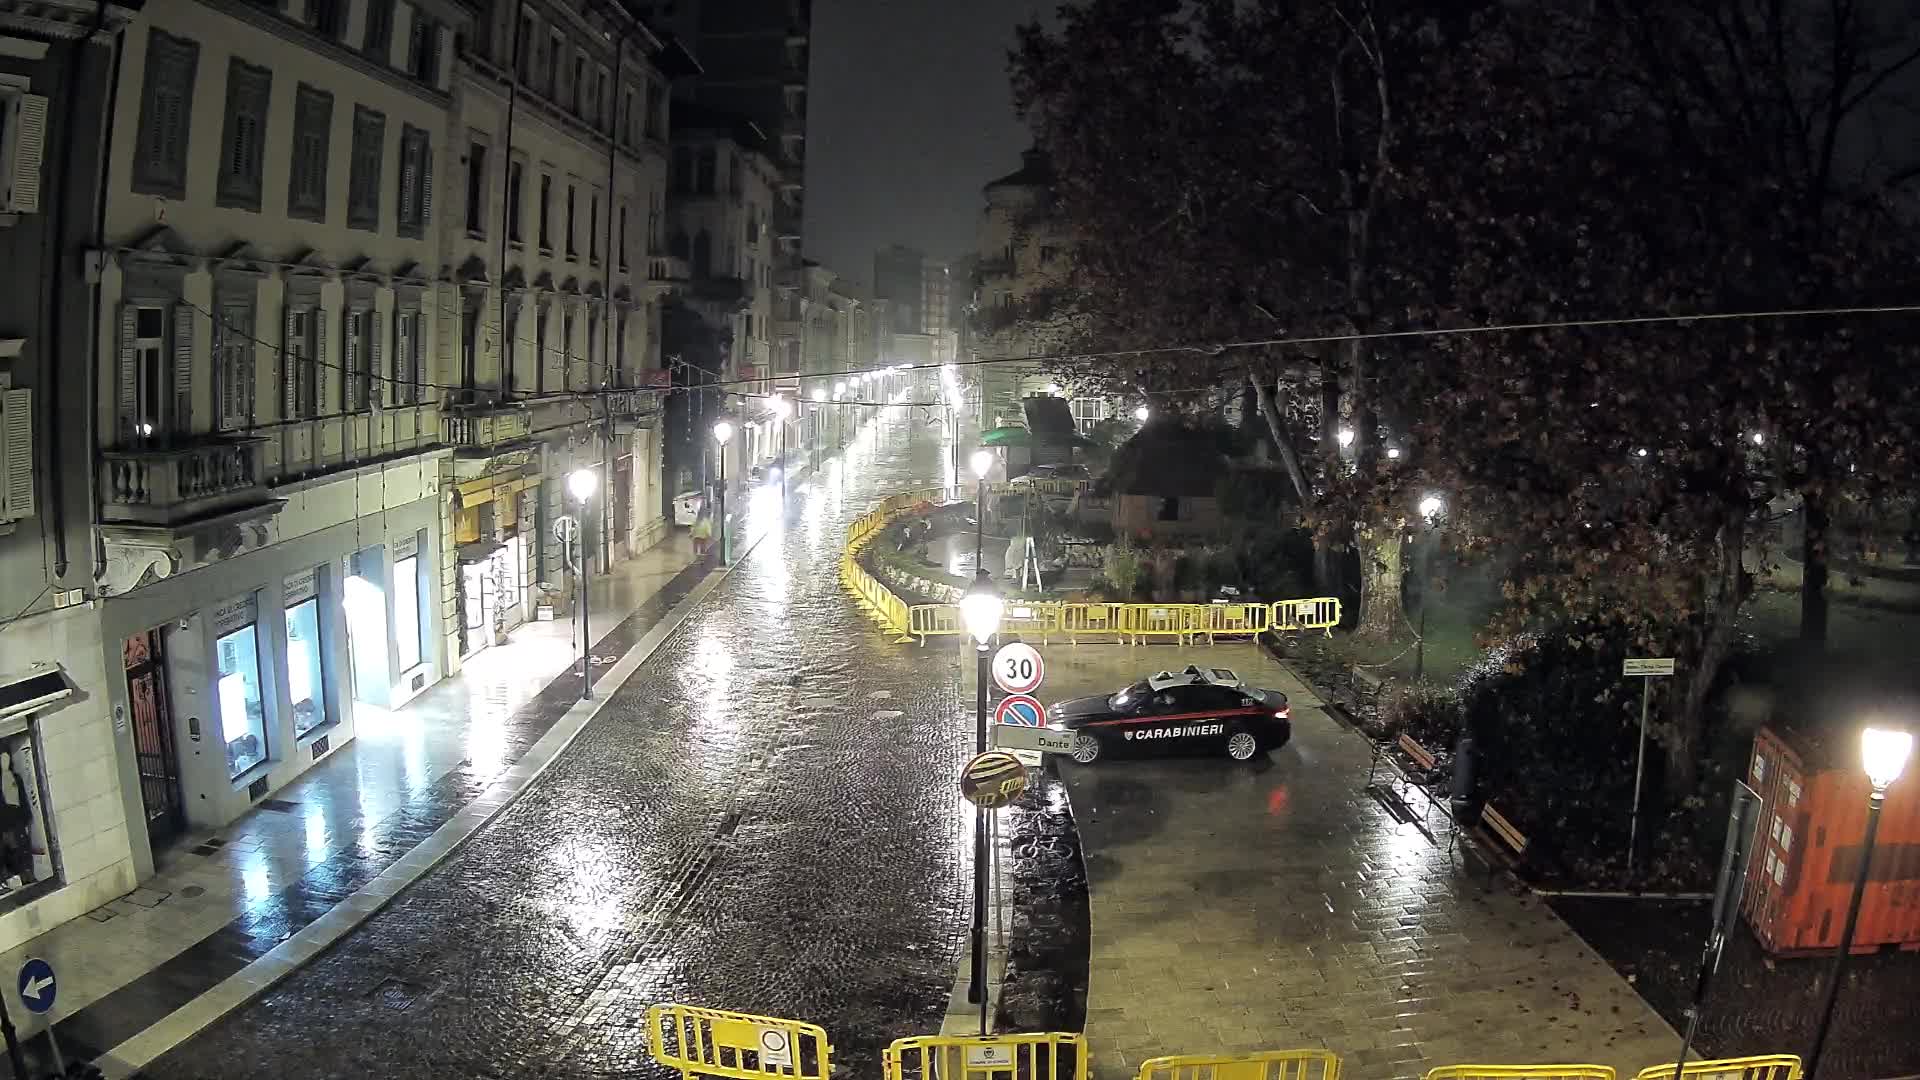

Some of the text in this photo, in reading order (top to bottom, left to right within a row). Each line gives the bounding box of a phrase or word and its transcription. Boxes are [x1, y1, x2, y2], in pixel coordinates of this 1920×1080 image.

[1006, 658, 1033, 680] 30
[1240, 698, 1254, 706] 112
[1136, 724, 1224, 740] CARABINIERI
[1038, 737, 1070, 749] Dante
